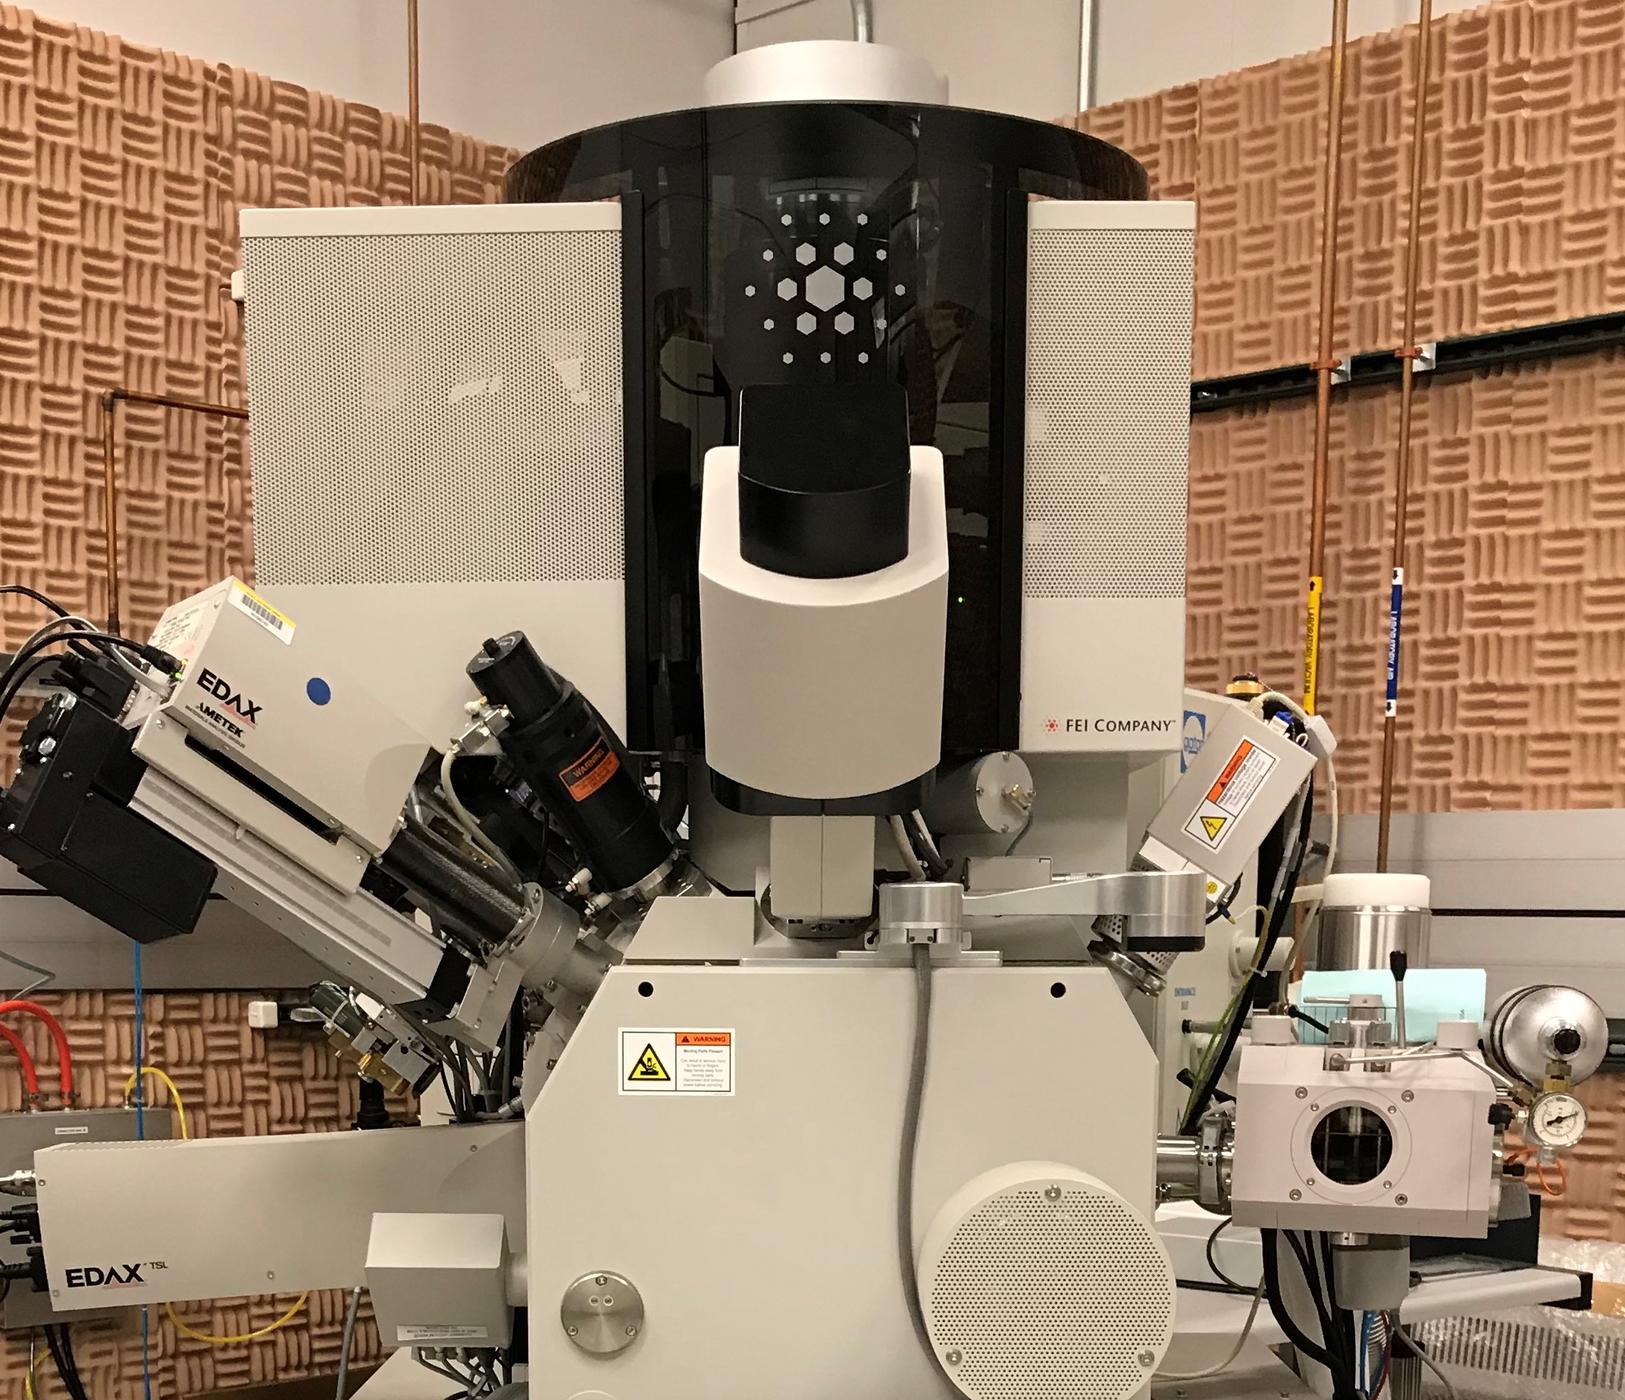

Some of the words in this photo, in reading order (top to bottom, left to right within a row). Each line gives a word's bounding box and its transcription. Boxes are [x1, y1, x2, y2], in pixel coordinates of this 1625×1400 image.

[196, 668, 262, 724] EDAX
[195, 702, 244, 738] AMETEK
[1066, 719, 1088, 732] FEI
[65, 1263, 144, 1288] EDAX
[150, 1261, 168, 1269] TSL
